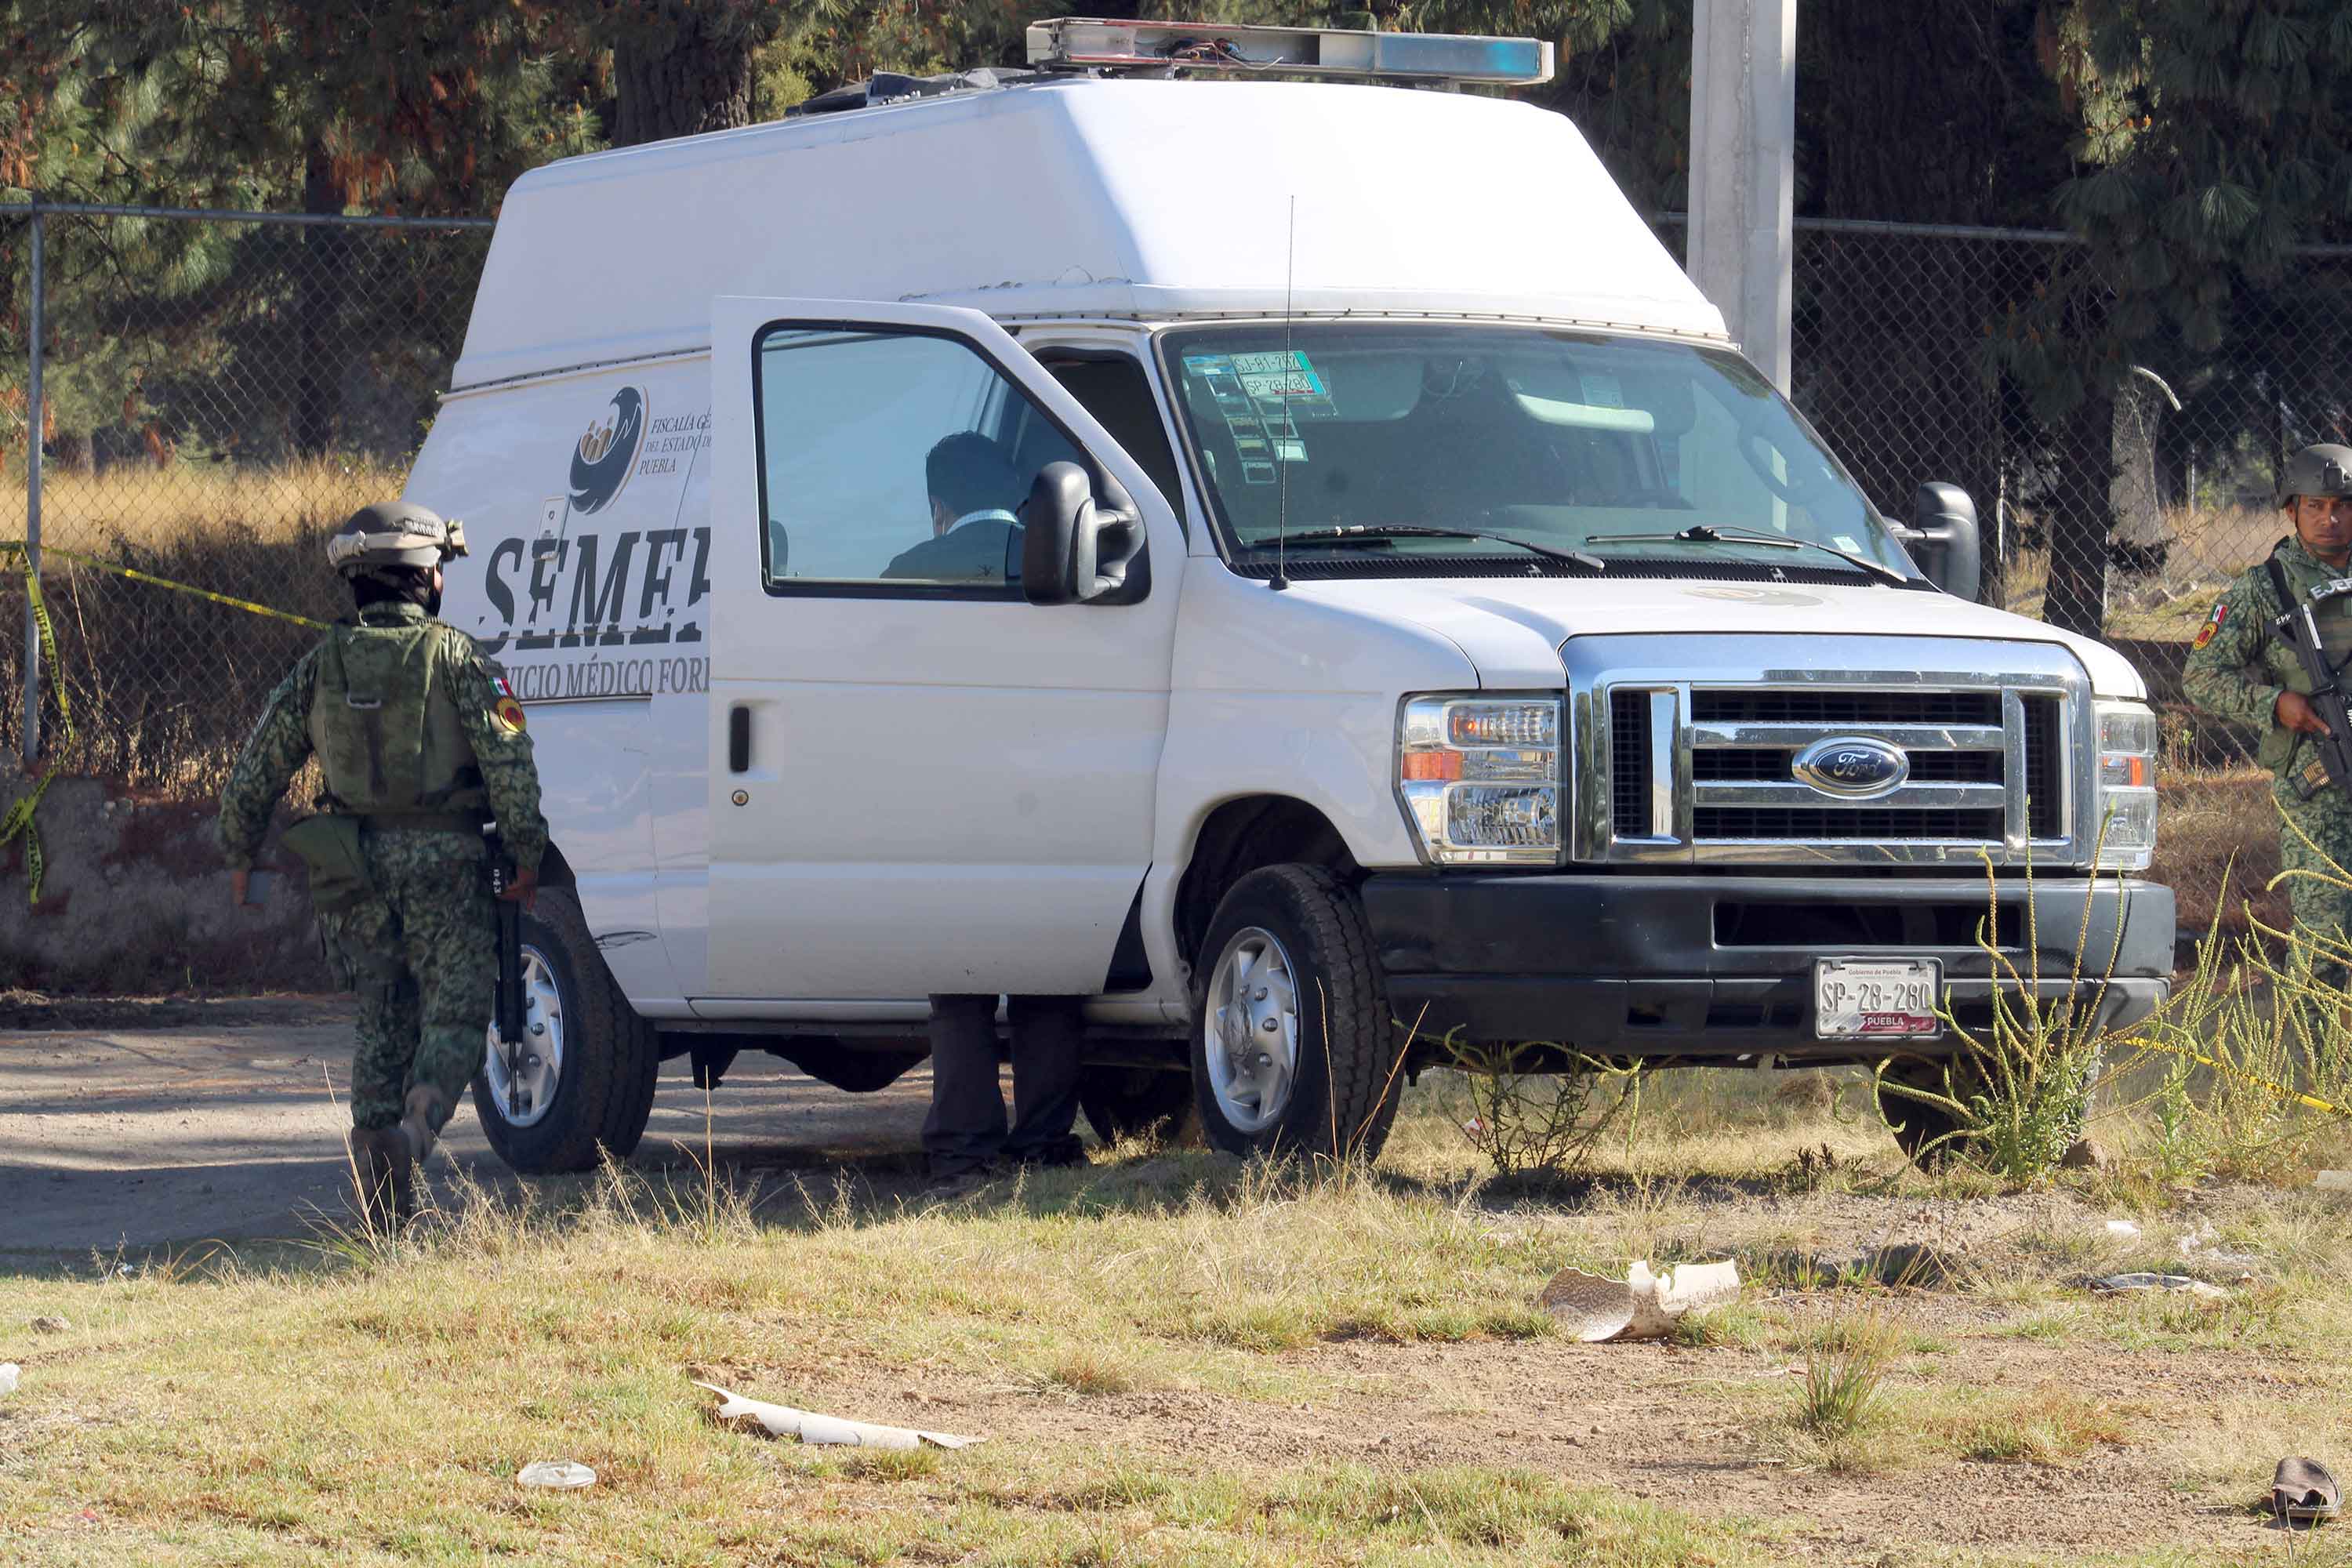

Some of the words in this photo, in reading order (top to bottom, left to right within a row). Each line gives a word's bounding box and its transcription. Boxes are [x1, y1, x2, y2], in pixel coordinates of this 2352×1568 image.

[652, 412, 695, 434] FISCALÍA
[639, 458, 677, 475] PUEBLA
[566, 652, 652, 698] MÉDICO
[1833, 753, 1881, 777] Ford
[1821, 982, 1933, 1012] SP-28-280
[1867, 1017, 1904, 1025] PUEBLA
